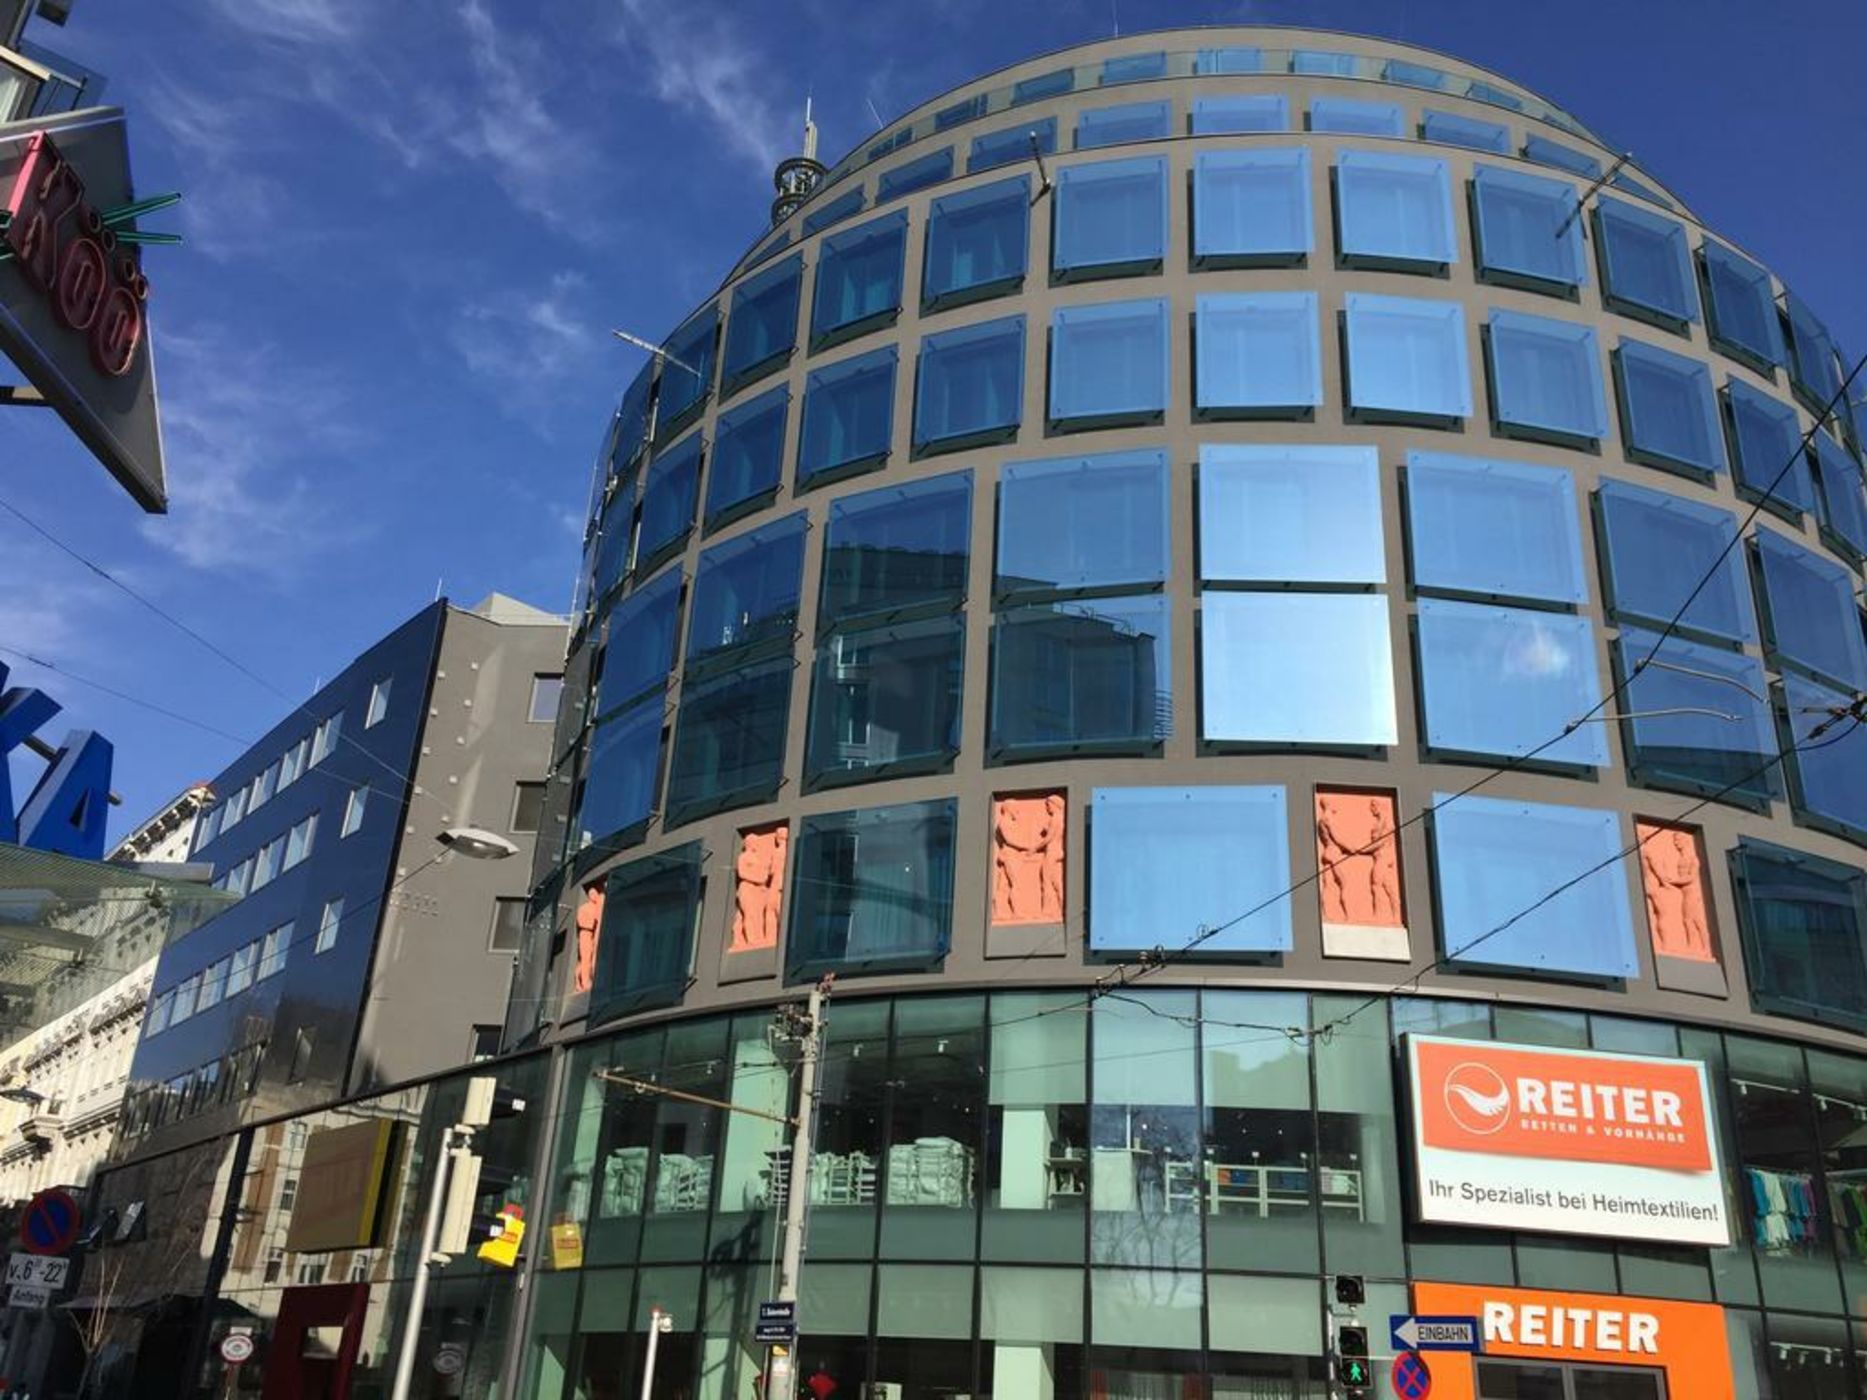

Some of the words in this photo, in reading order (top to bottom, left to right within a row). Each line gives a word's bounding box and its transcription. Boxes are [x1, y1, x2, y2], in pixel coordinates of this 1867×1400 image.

[1516, 1077, 1684, 1127] REITER
[1520, 1119, 1578, 1134] BETTEN
[1586, 1126, 1596, 1135] &
[1429, 1179, 1455, 1198] Ihr
[1460, 1182, 1553, 1208] Spezialist
[1558, 1190, 1587, 1211] bei
[1592, 1193, 1720, 1221] Heimtextilien!
[1418, 1326, 1470, 1343] EINBAHN
[1483, 1302, 1660, 1354] REITER
